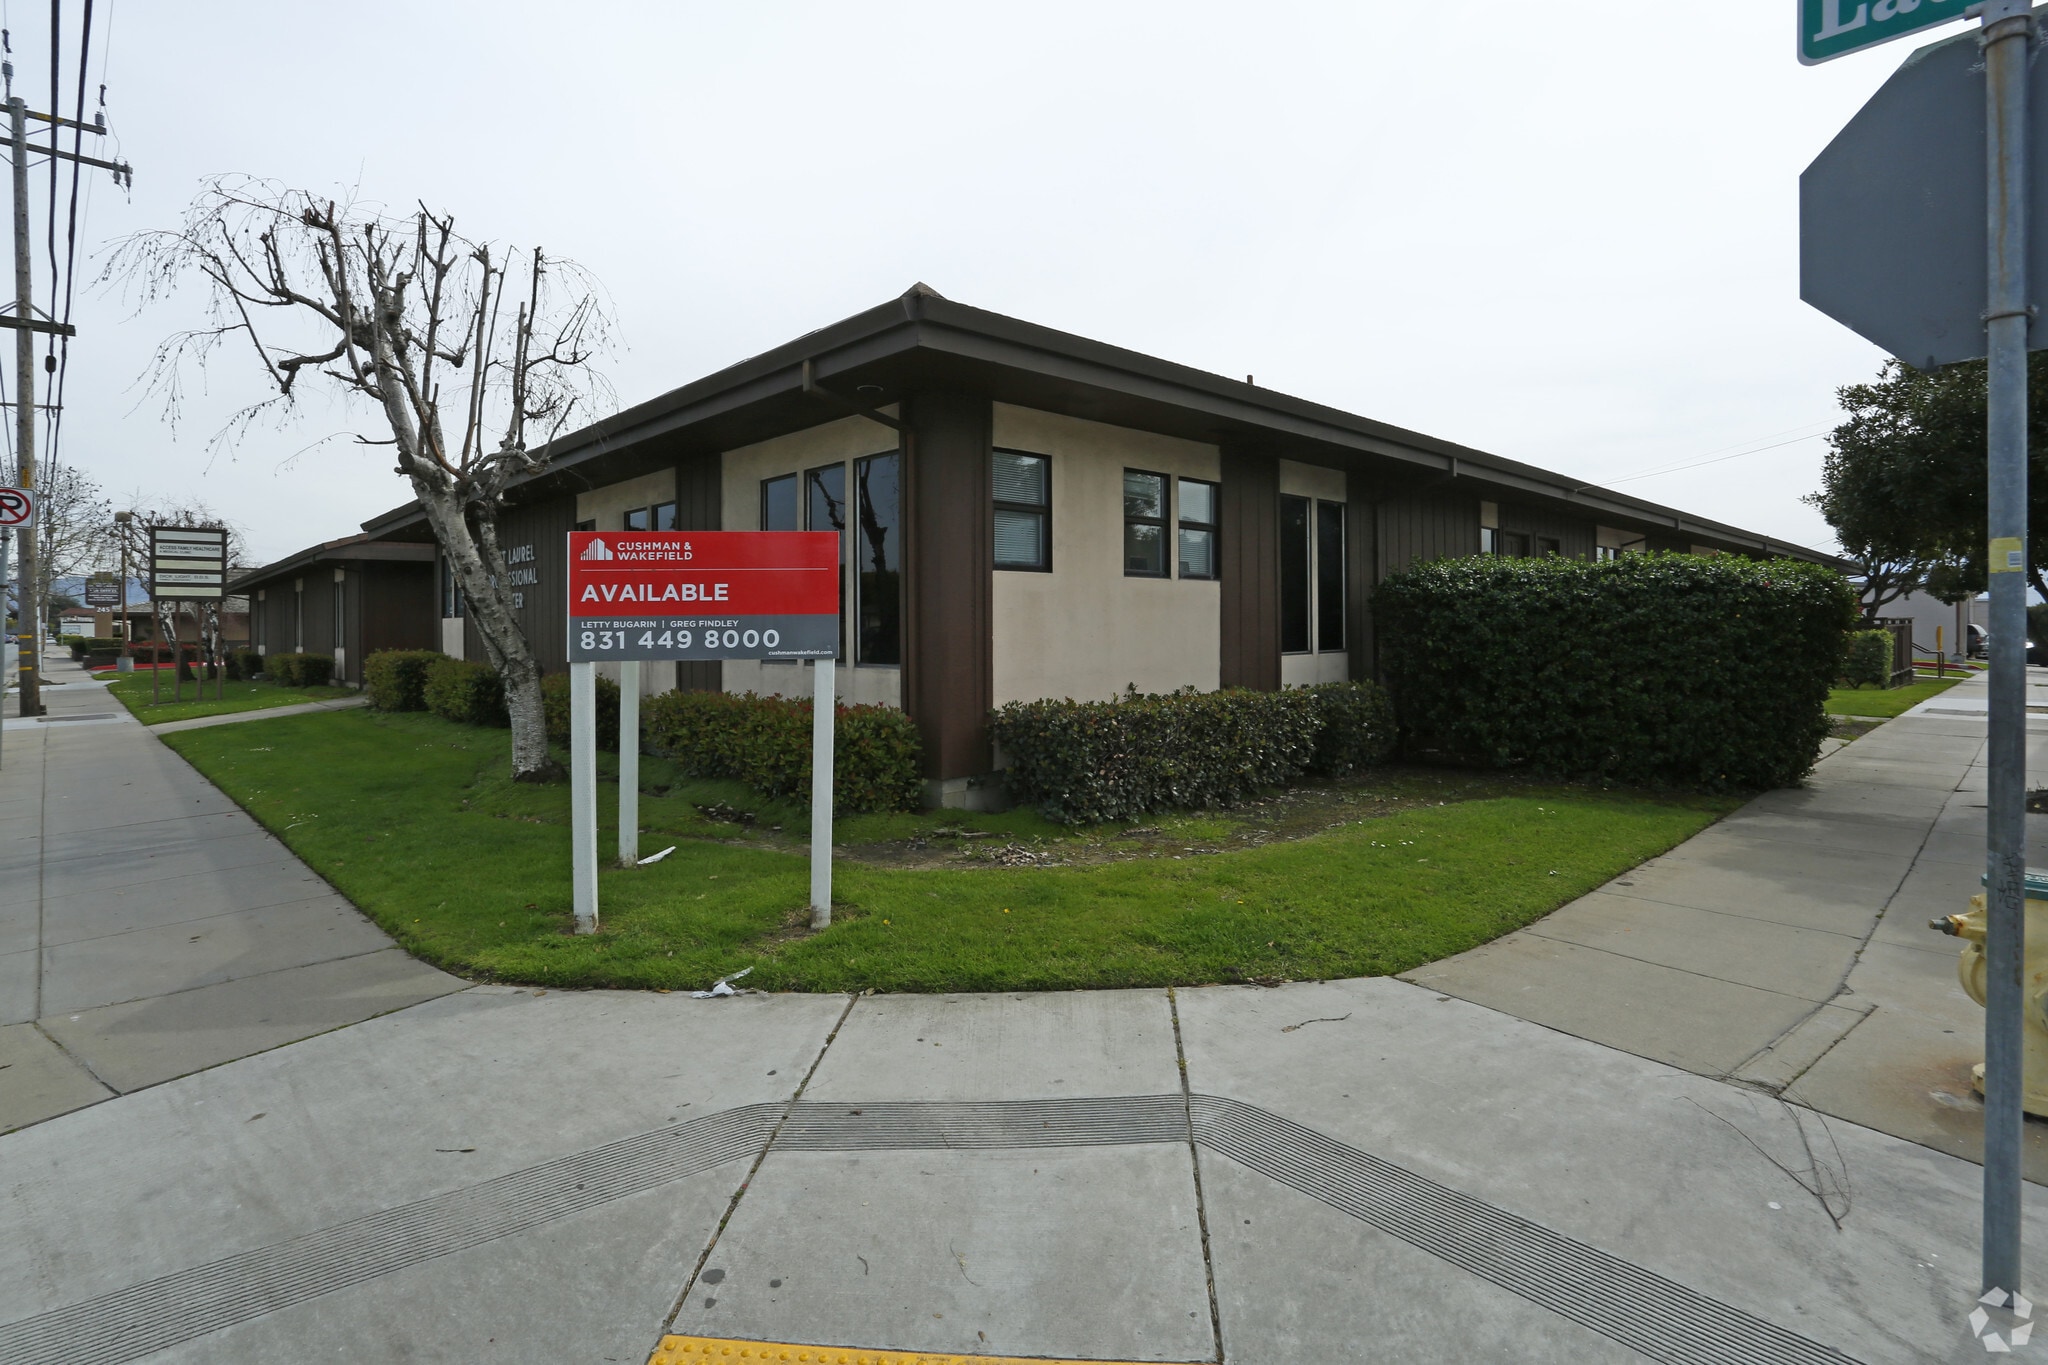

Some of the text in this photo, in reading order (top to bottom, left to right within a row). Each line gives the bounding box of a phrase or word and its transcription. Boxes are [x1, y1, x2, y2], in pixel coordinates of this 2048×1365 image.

[617, 541, 692, 551] CUSHMAN &
[508, 545, 535, 565] LAUREL
[617, 551, 693, 561] WAKEFIELD
[580, 583, 729, 602] AVAILABLE
[581, 621, 611, 629] LETTY
[613, 620, 657, 629] BUGARIN
[670, 620, 696, 628] GREG
[698, 620, 739, 628] FINDLEY
[580, 629, 780, 650] 831 449 8000
